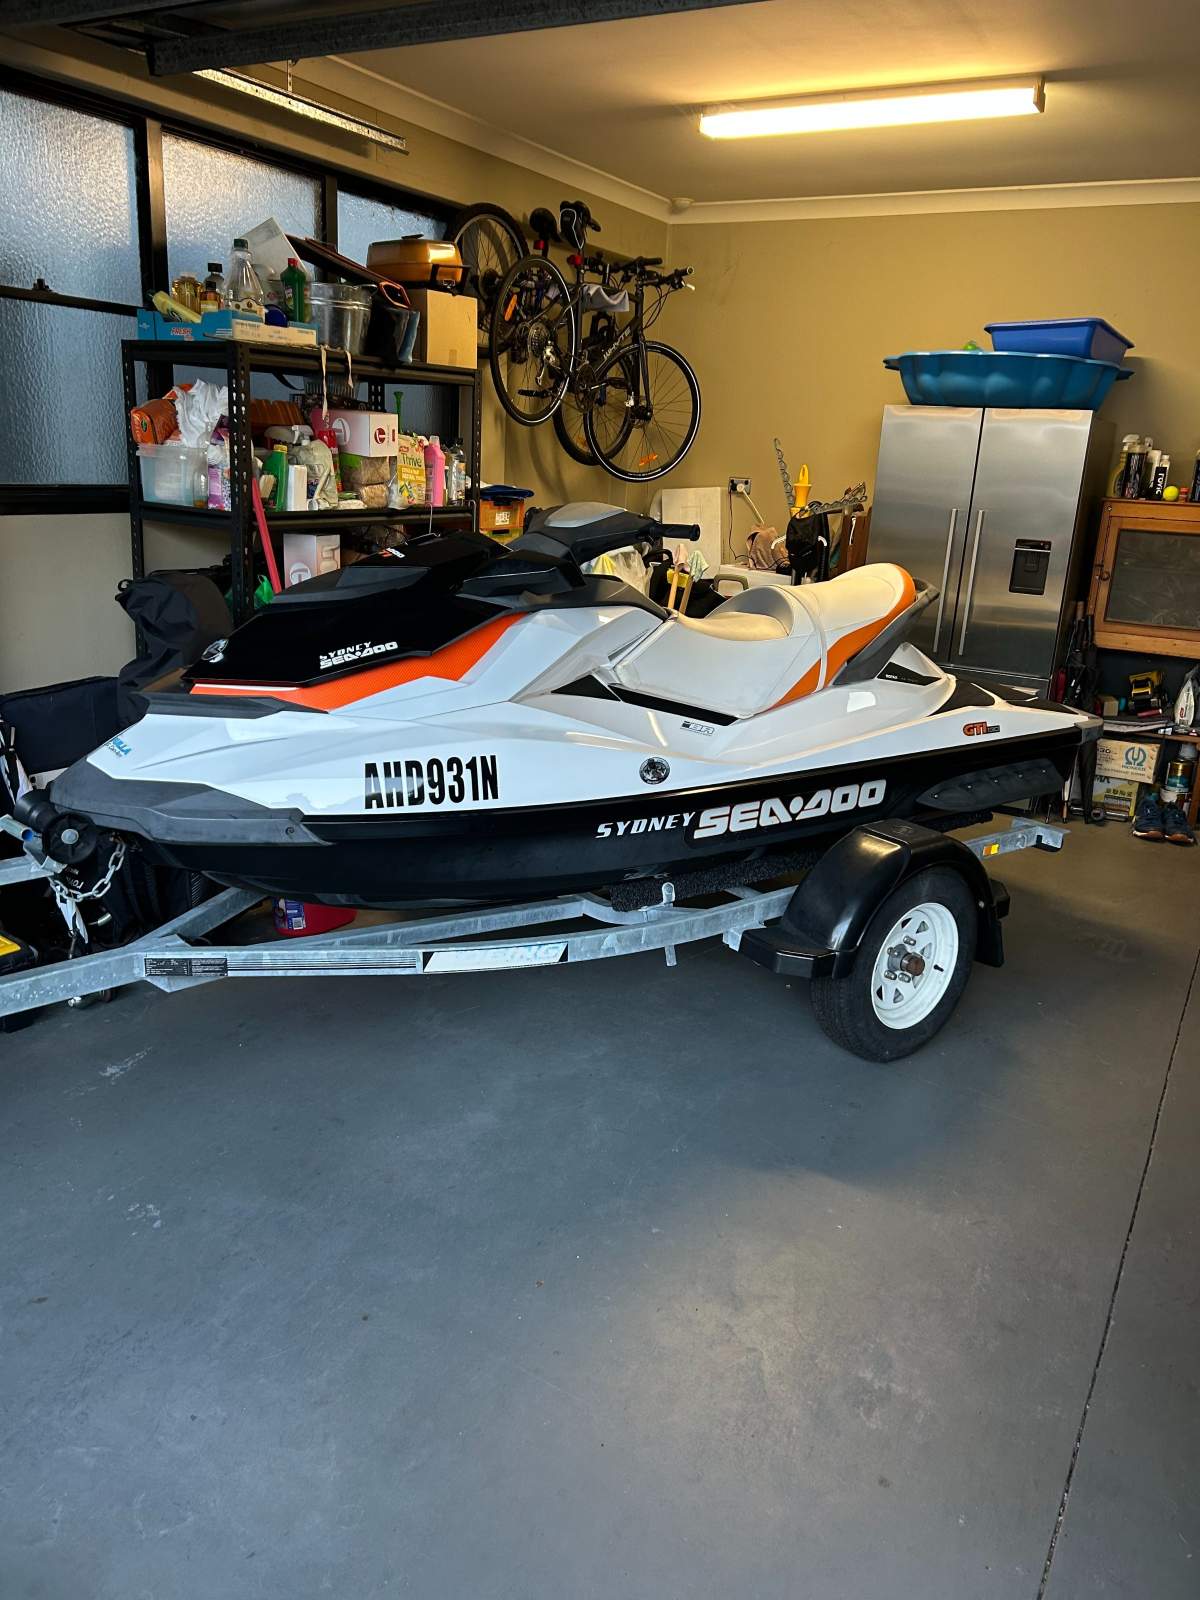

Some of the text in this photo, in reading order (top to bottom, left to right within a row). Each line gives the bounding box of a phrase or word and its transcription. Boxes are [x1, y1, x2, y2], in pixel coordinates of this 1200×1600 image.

[401, 452, 422, 468] Thrive
[319, 641, 372, 660] SYDNEY
[962, 721, 987, 736] GTI
[364, 754, 499, 809] AHD931N
[595, 811, 696, 839] SYDNEY
